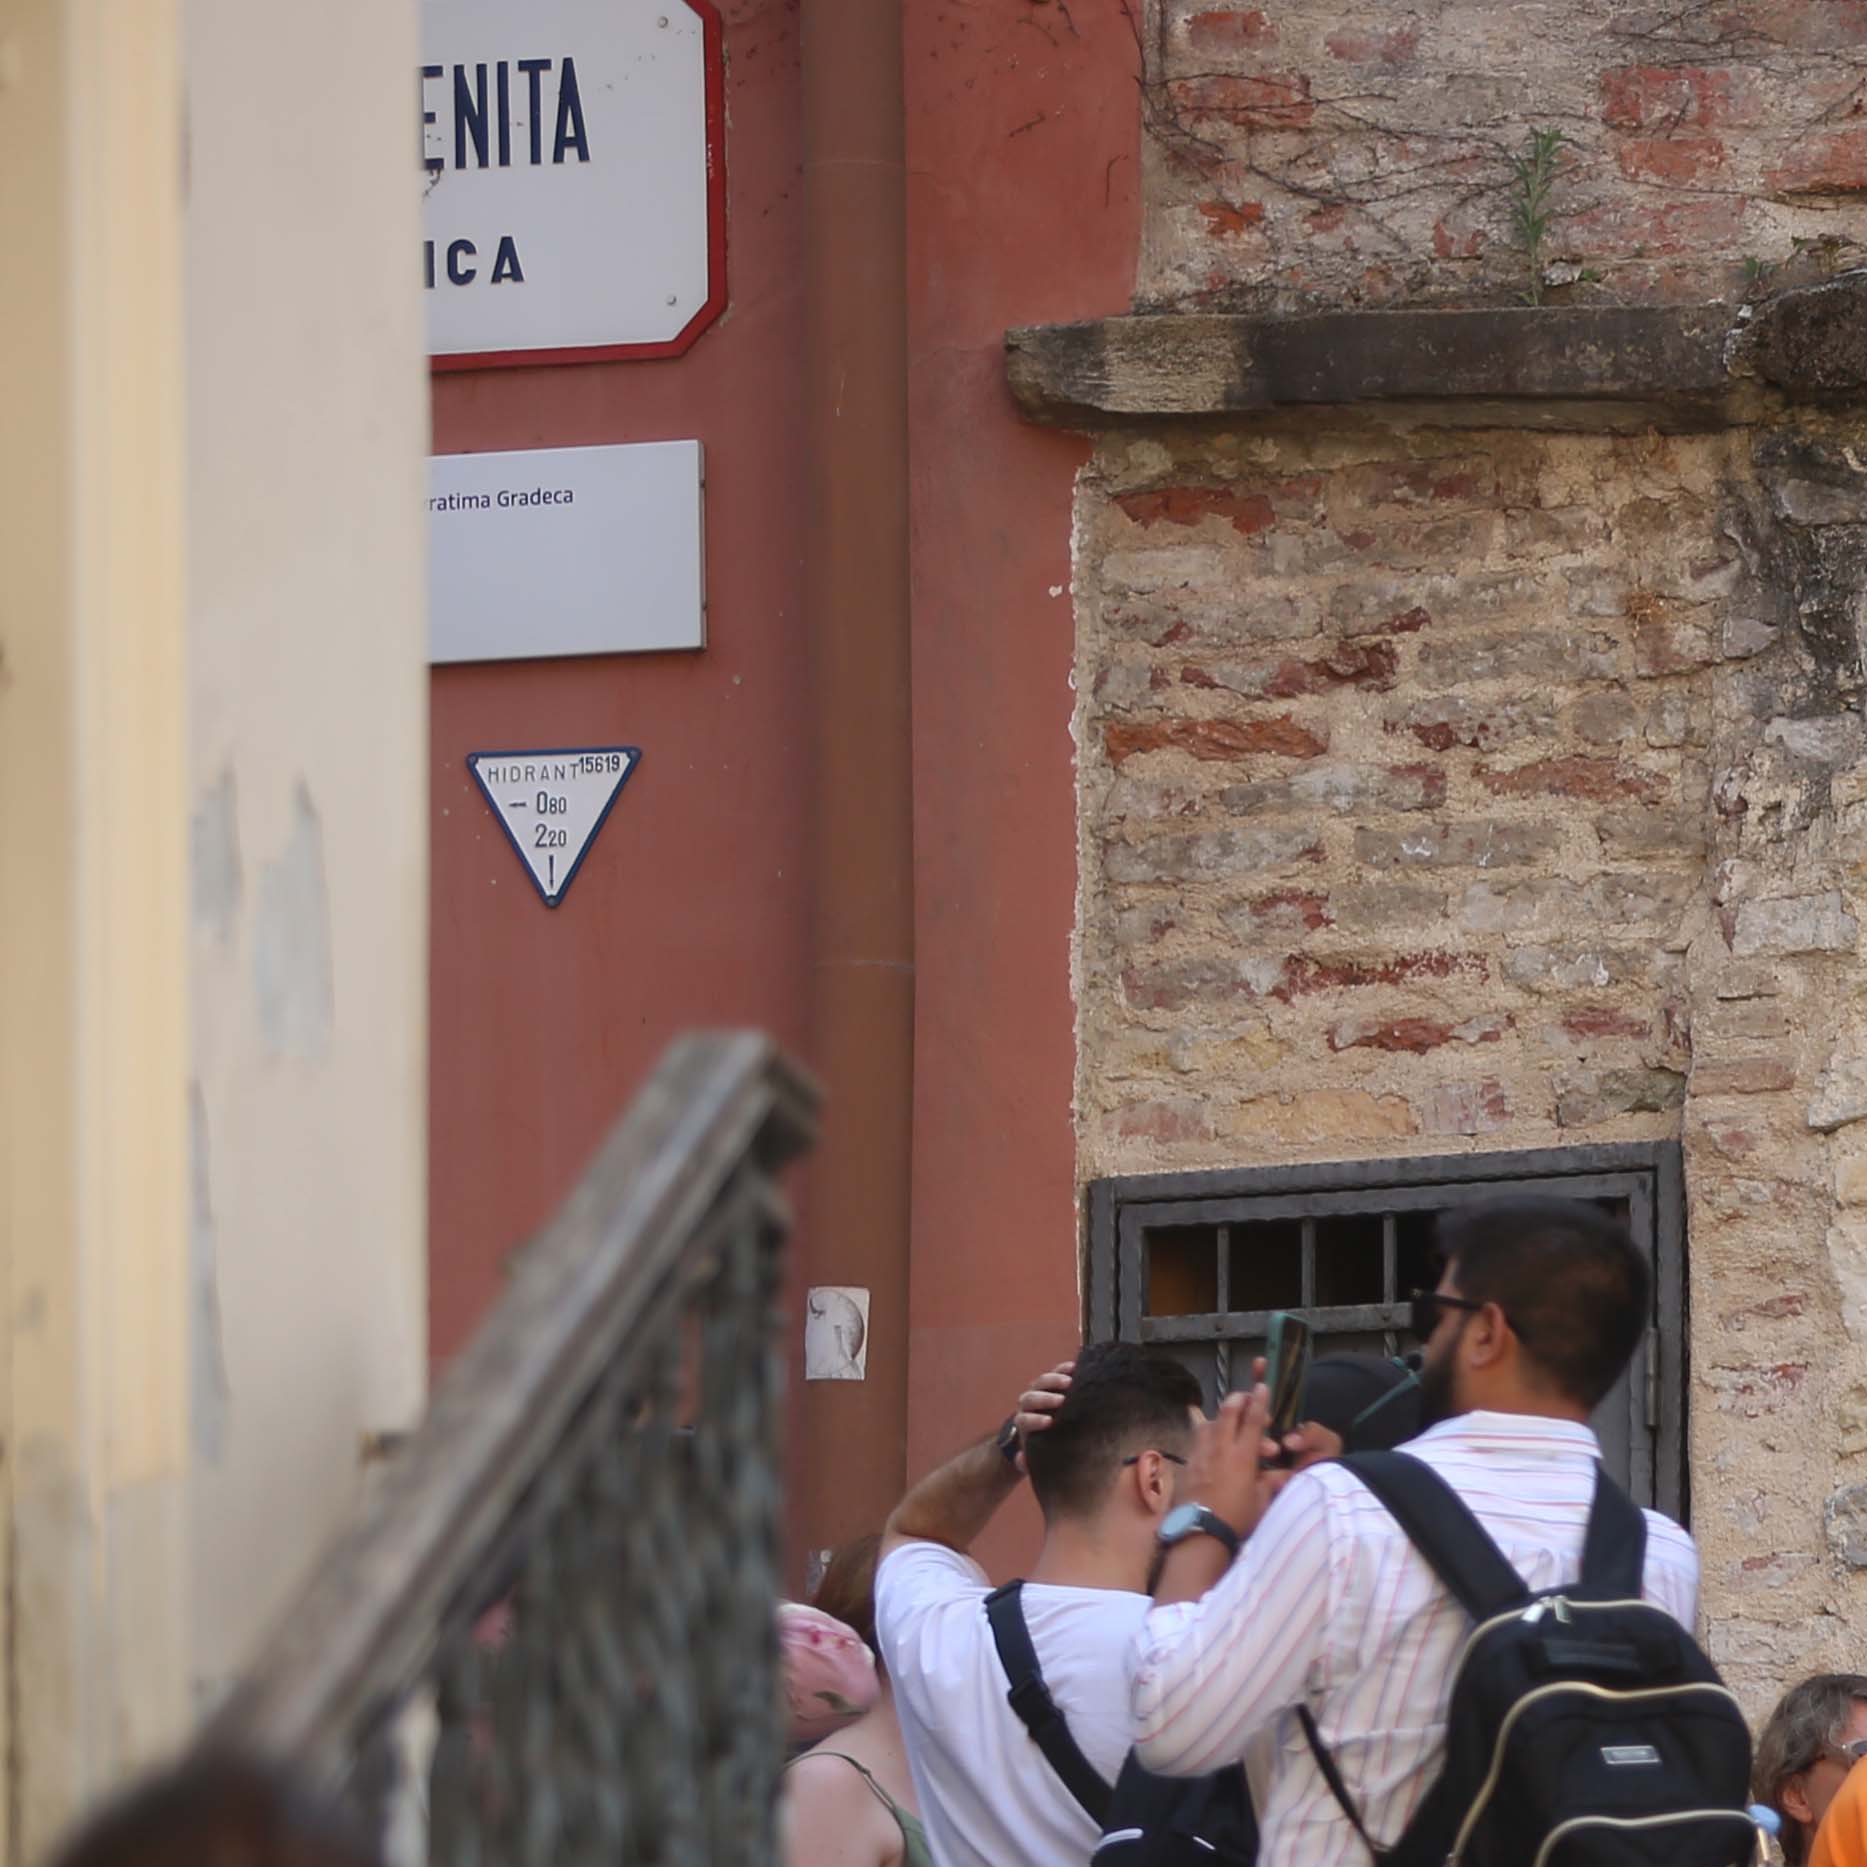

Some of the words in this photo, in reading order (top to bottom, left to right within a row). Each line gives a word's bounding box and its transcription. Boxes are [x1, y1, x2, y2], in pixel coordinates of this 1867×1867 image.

[420, 57, 591, 170] ENITA
[423, 235, 525, 289] ICA
[429, 492, 491, 512] ratima
[496, 487, 574, 508] Gradeca
[487, 763, 579, 784] HIDRANT
[579, 754, 621, 774] 15619
